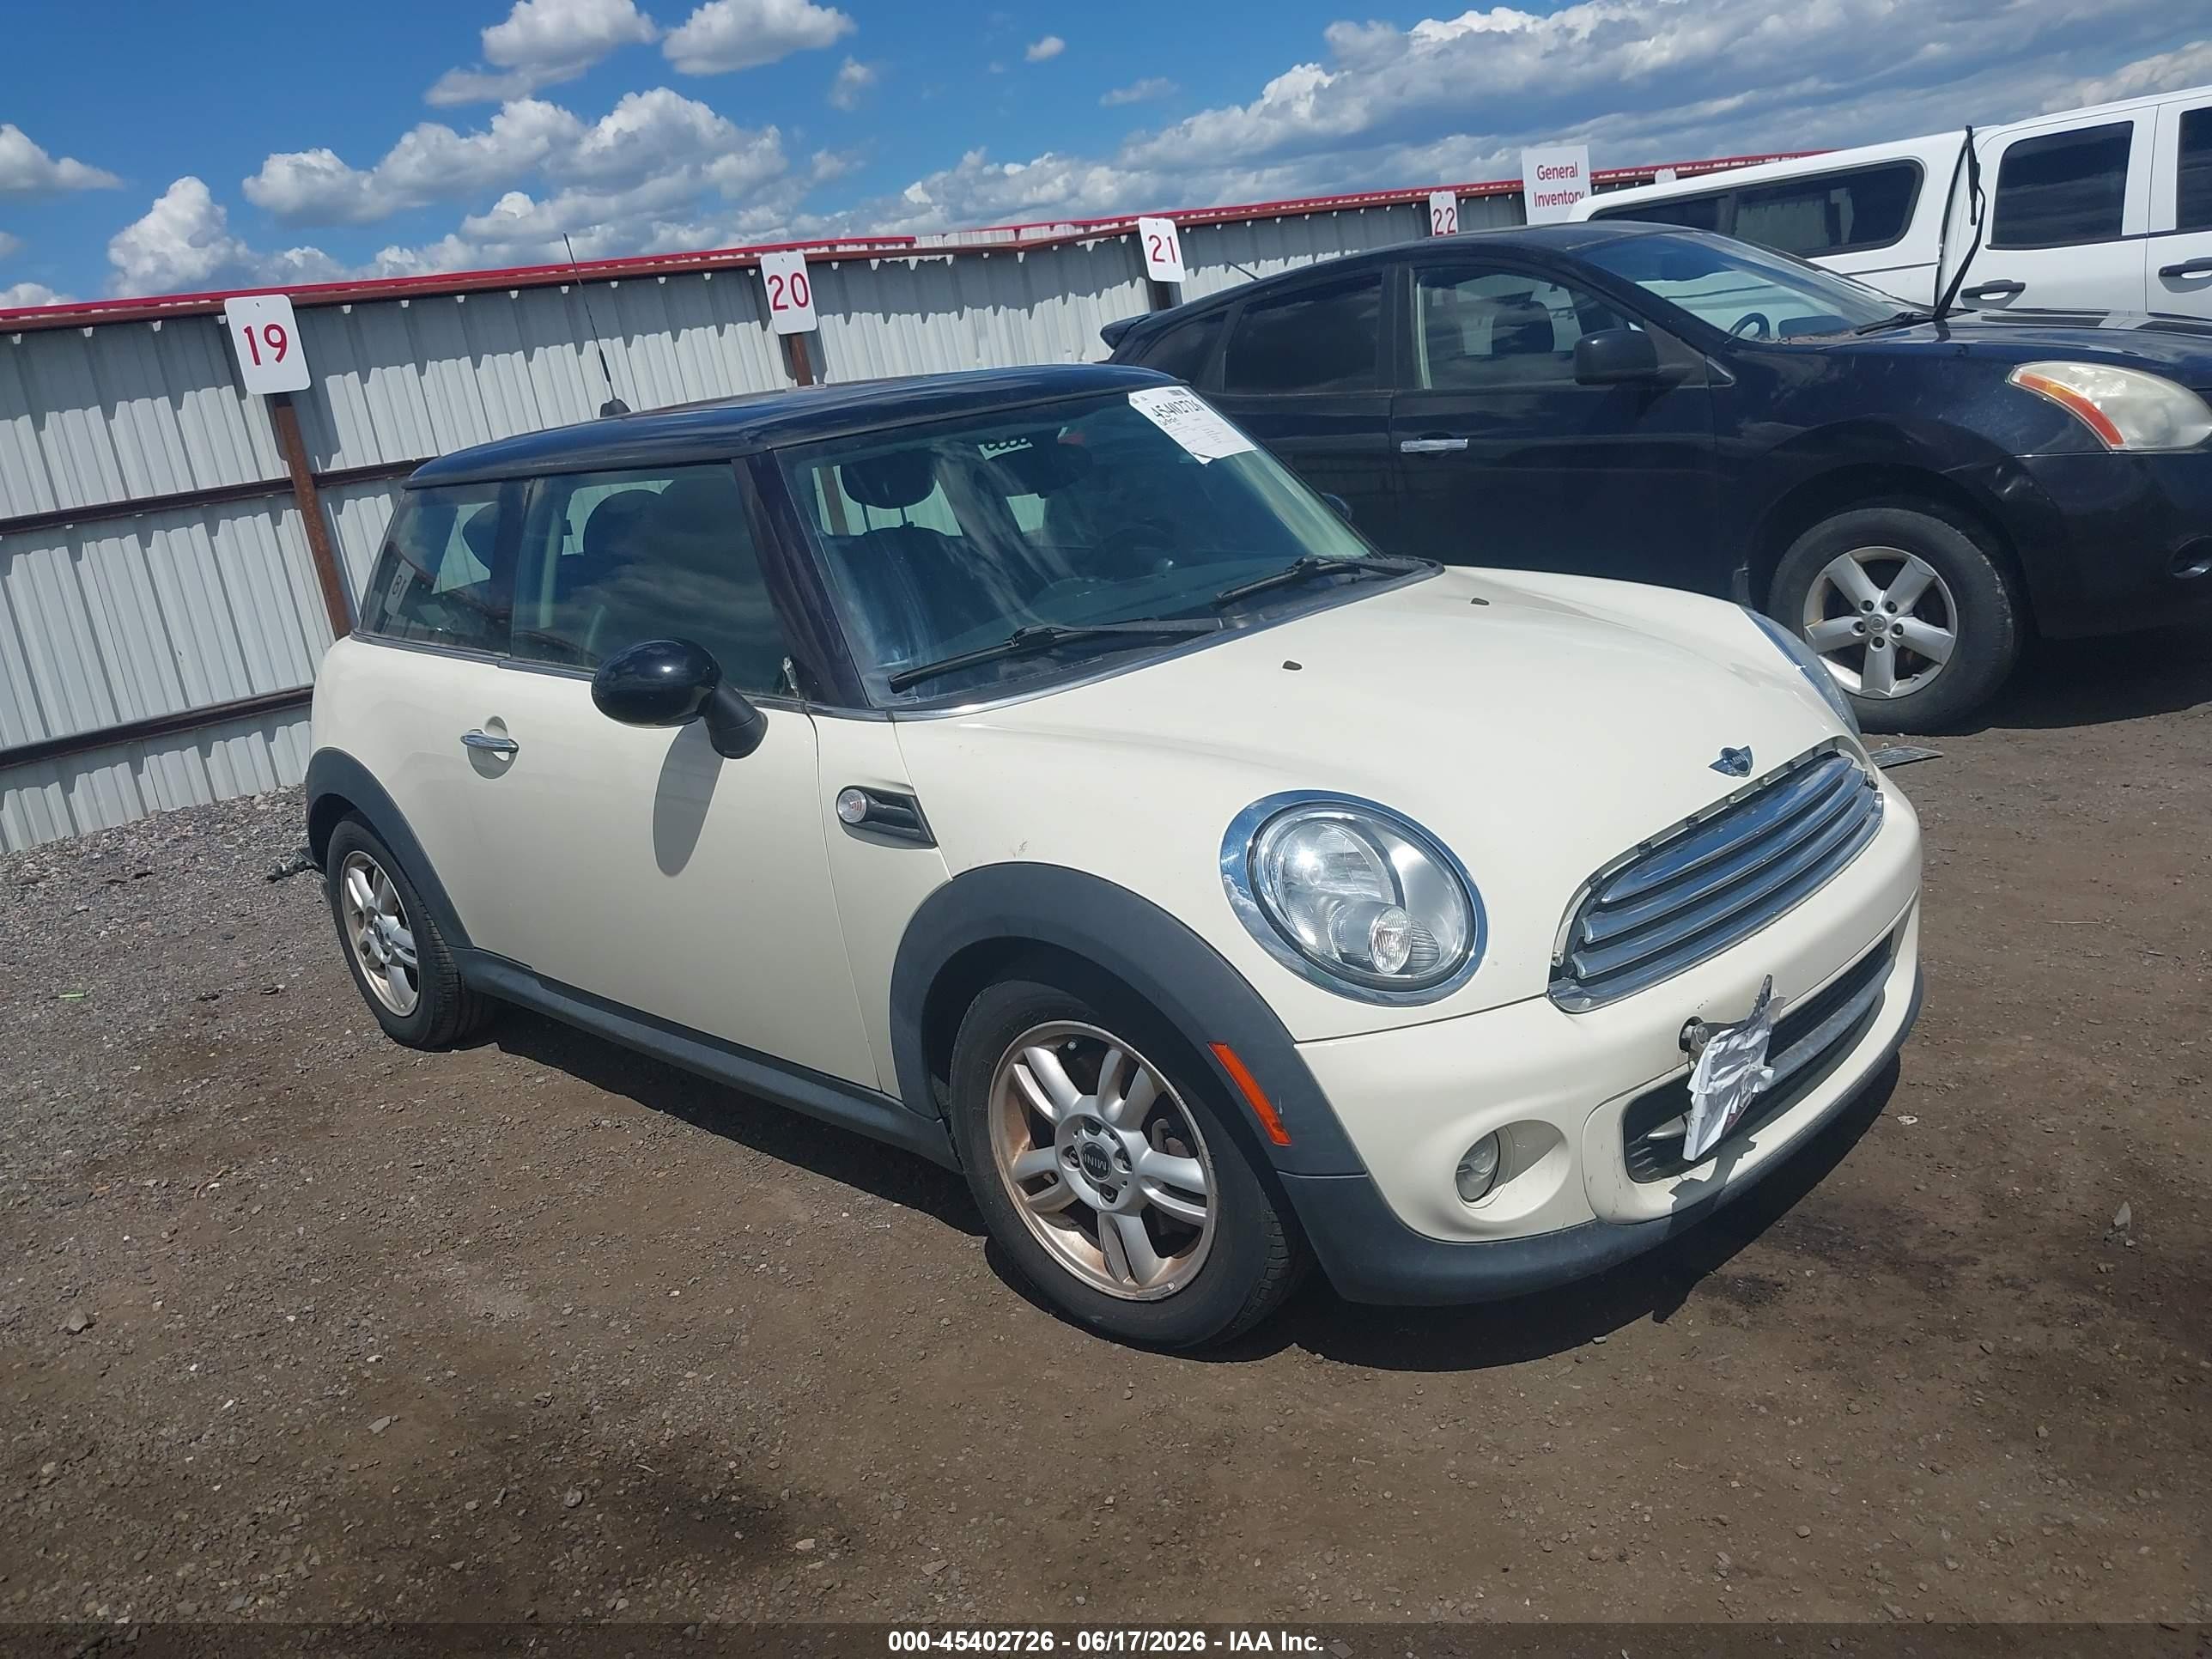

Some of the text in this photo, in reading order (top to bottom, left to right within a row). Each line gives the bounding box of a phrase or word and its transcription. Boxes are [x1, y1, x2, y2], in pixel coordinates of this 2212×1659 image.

[1536, 161, 1578, 180] General
[1433, 207, 1456, 234] 22
[1148, 234, 1176, 264] 21
[768, 272, 809, 311] 20
[243, 324, 288, 366] 19
[1084, 1153, 1107, 1170] MINI
